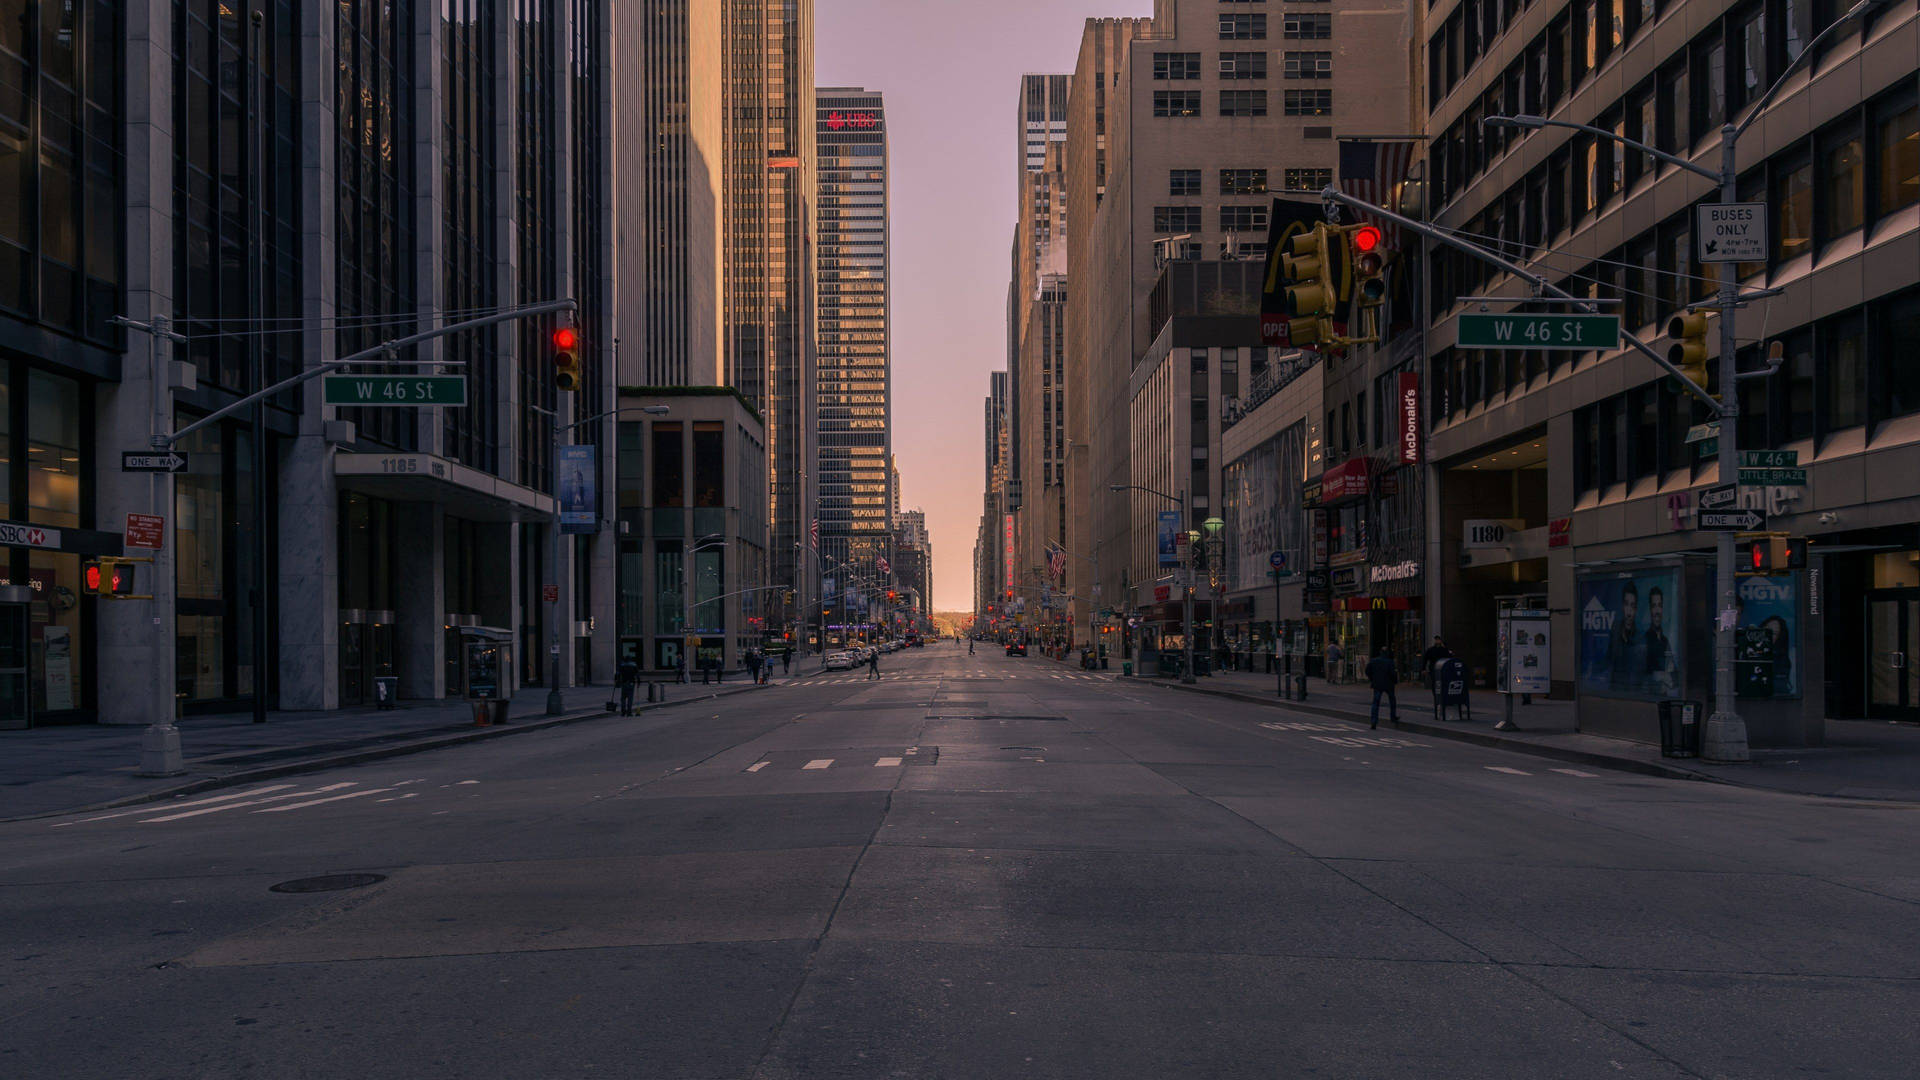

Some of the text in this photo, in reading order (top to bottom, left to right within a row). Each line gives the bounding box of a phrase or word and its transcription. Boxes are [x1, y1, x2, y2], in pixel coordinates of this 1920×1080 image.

[847, 113, 876, 127] UBS
[1711, 209, 1753, 221] BUSES
[1716, 224, 1749, 236] ONLY
[1752, 247, 1763, 255] FRI
[1495, 321, 1583, 342] W 46 St
[356, 381, 434, 399] W 46 St
[1405, 389, 1416, 461] McDonald's
[131, 457, 178, 466] ONE WAY
[381, 458, 417, 472] 1185
[1749, 452, 1760, 466] W
[1765, 452, 1784, 466] 46
[1738, 470, 1806, 480] LITTLE BRAZIL
[1704, 488, 1734, 505] ONE WAY
[1707, 515, 1757, 525] ONE WAY
[1472, 525, 1504, 542] 1180
[1371, 560, 1418, 583] McDonald's
[1739, 583, 1790, 601] HGTV
[1810, 568, 1820, 615] Newsstand
[1583, 610, 1616, 631] HGTV
